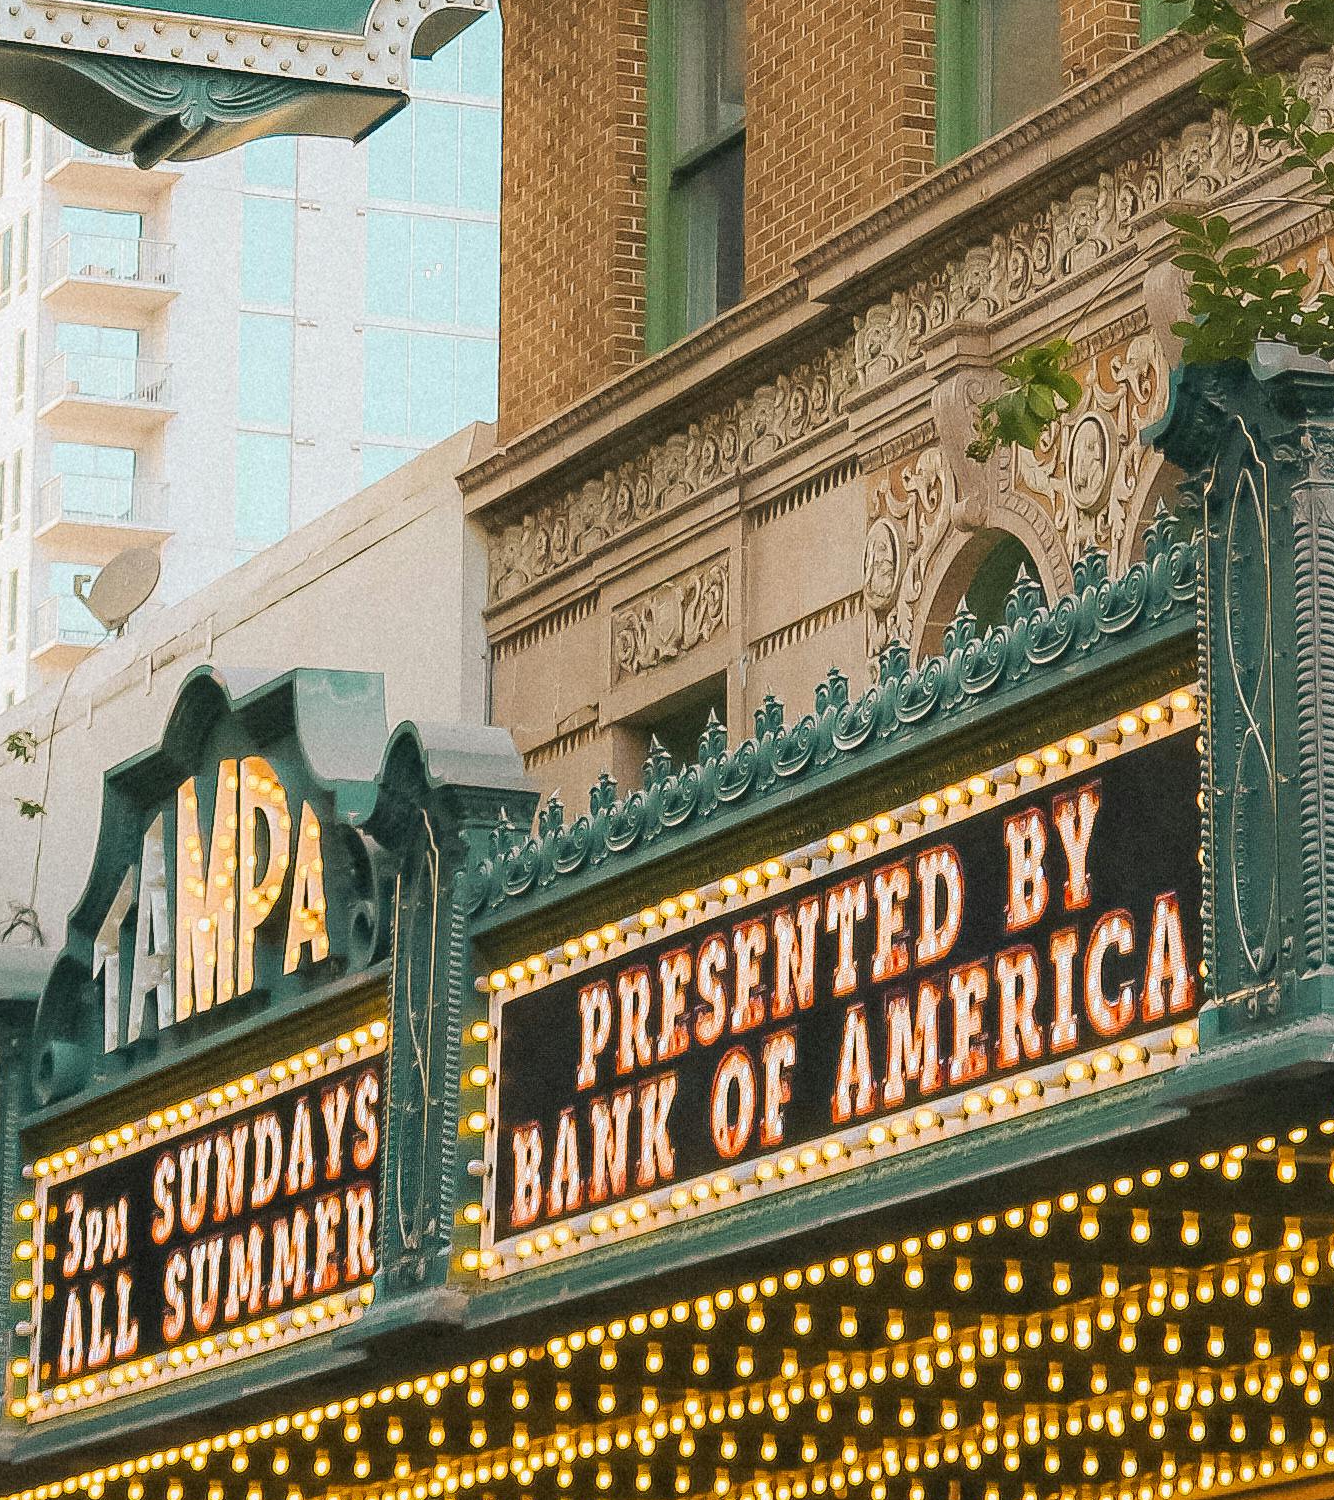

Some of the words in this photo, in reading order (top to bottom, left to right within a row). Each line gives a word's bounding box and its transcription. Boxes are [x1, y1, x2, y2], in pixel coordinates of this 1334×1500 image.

[94, 756, 329, 1054] TAMPA
[577, 845, 965, 1092] PRESENTED
[1002, 782, 1104, 934] BY
[64, 1194, 130, 1276] 3PM
[153, 1070, 381, 1245] SUNDAYS
[510, 1074, 677, 1226] BANK
[710, 1036, 797, 1158] OF
[830, 893, 1196, 1123] AMERICA
[60, 1273, 138, 1376] ALL
[163, 1185, 377, 1342] SUMMER
